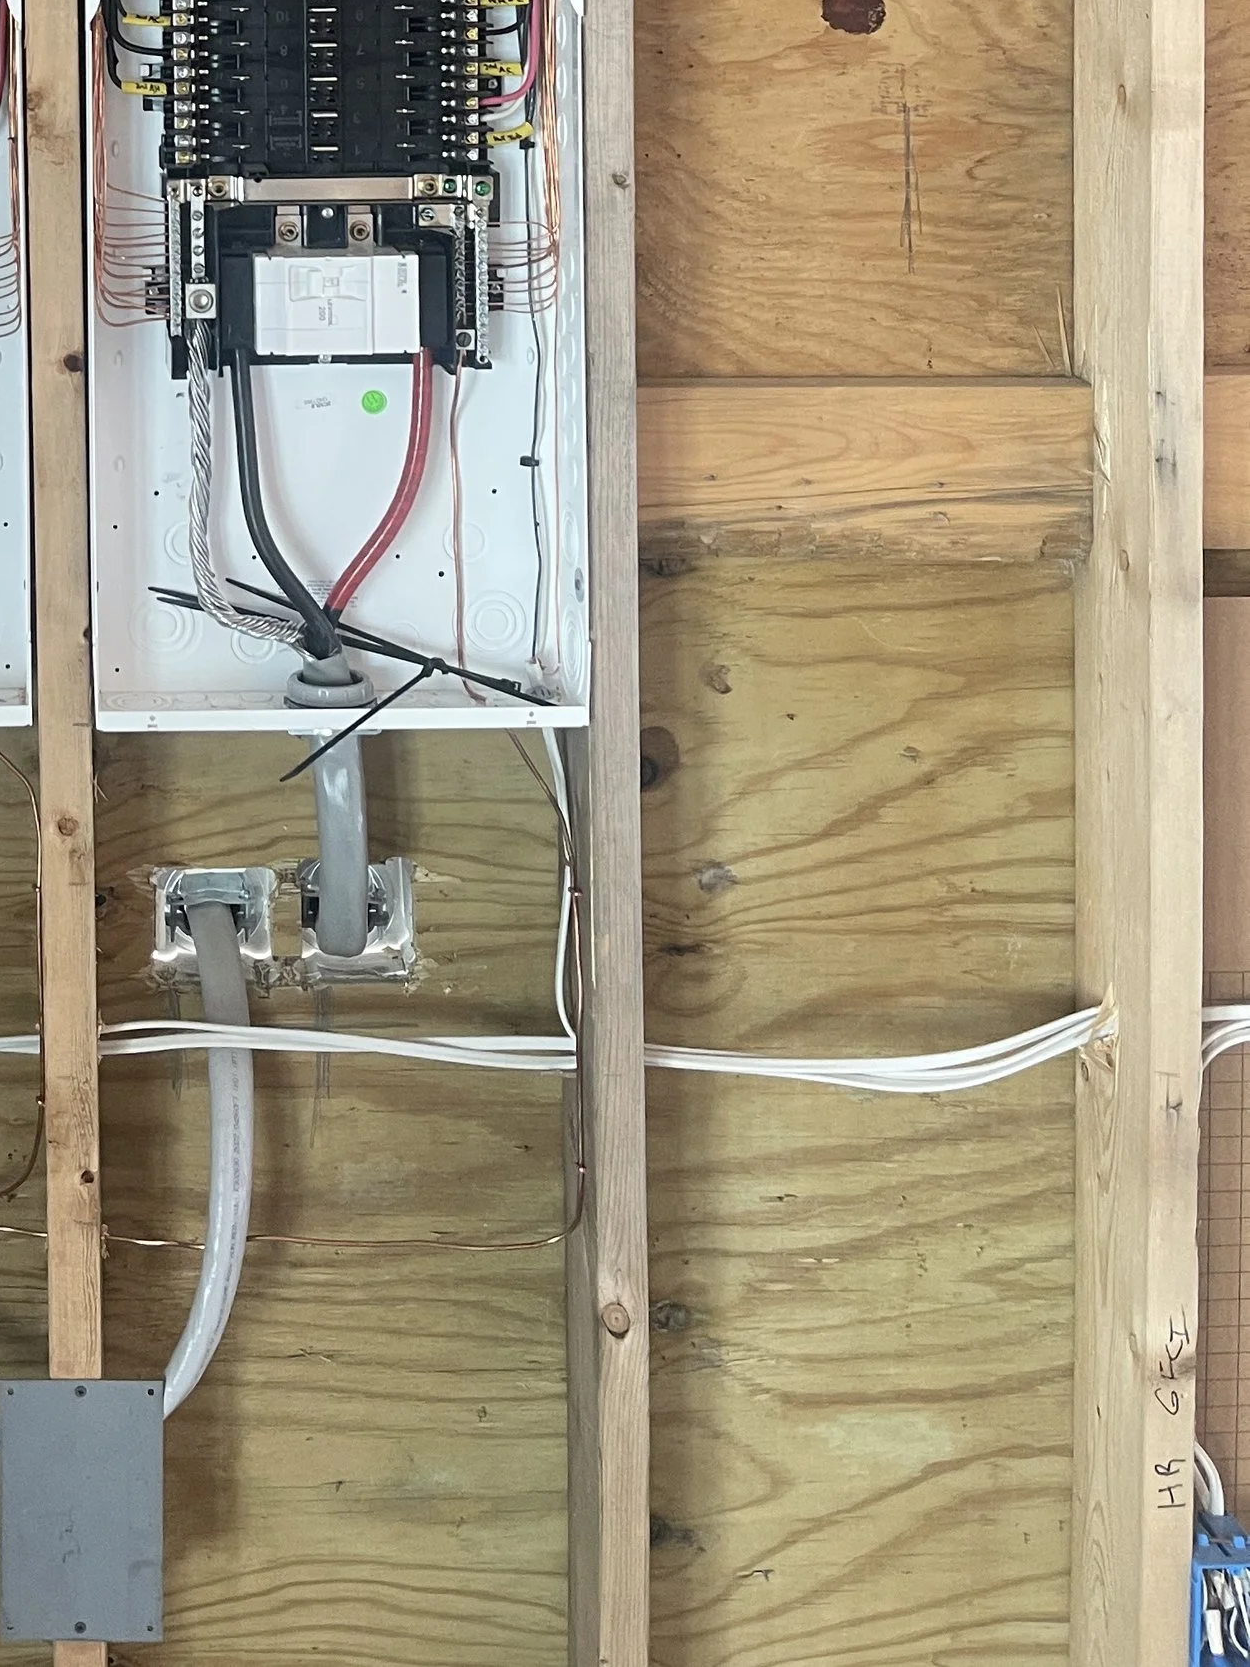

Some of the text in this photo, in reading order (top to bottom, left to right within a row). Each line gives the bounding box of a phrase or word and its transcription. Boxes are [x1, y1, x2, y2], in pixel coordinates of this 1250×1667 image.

[318, 306, 326, 321] 200
[1154, 1303, 1190, 1509] HR GFCI
